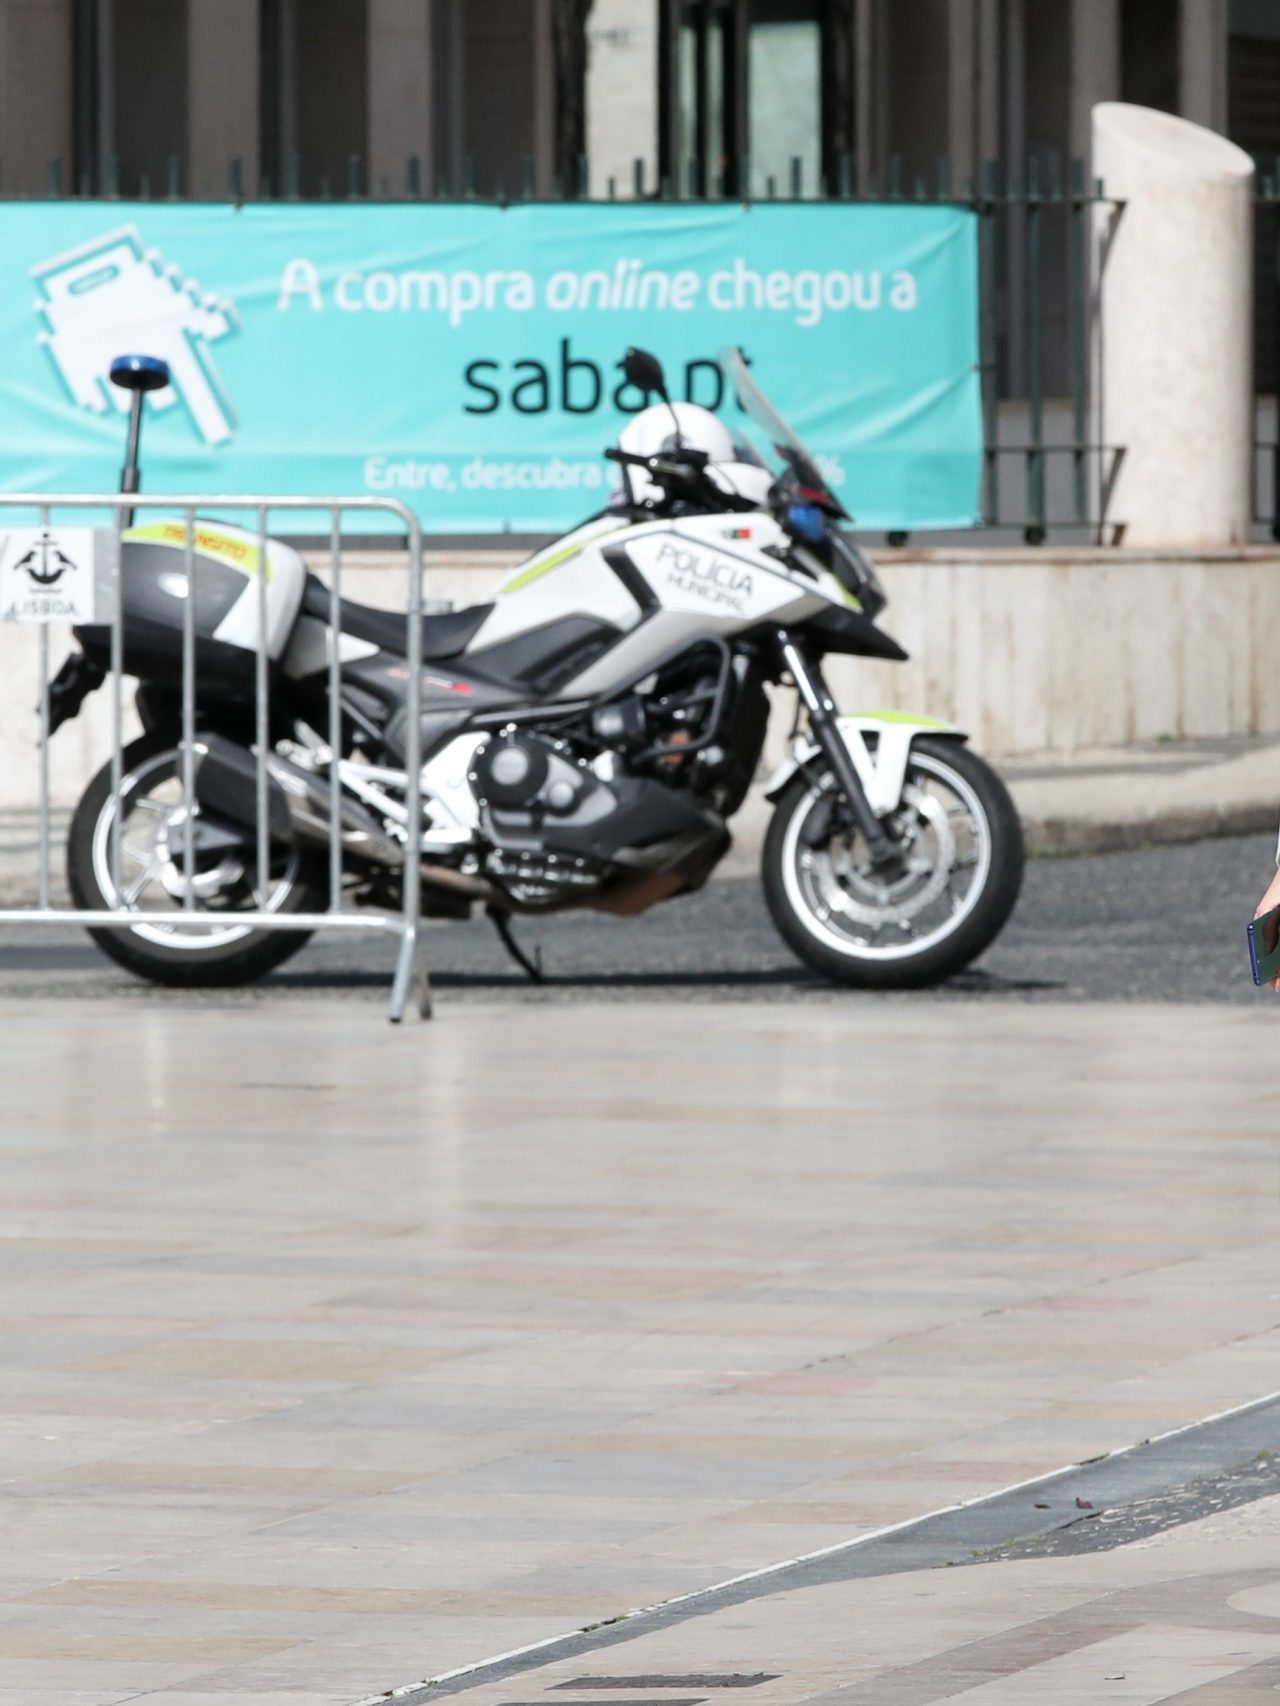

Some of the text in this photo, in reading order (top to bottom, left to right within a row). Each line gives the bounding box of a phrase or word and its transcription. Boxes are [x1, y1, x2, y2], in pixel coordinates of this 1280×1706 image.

[276, 257, 918, 328] A compra online chegou a
[363, 456, 457, 493] Entre,
[461, 456, 602, 490] descubra
